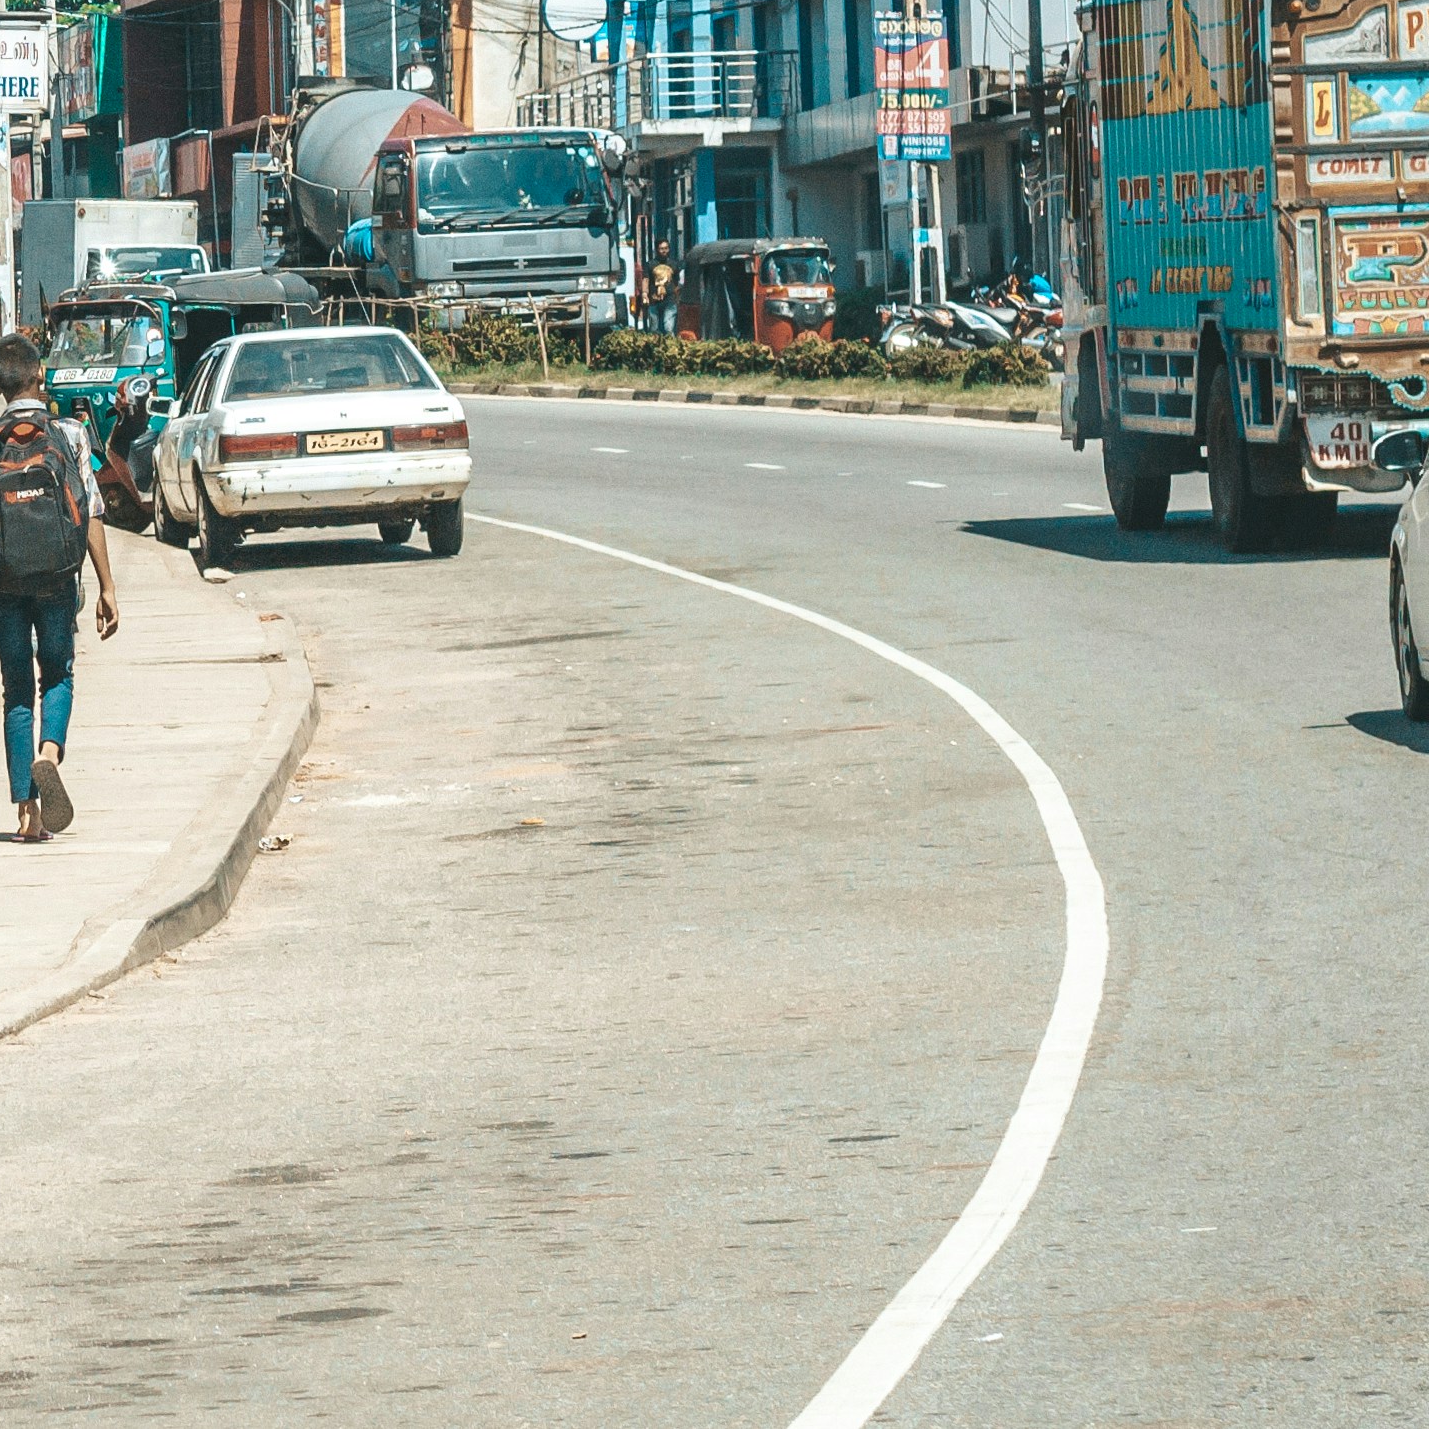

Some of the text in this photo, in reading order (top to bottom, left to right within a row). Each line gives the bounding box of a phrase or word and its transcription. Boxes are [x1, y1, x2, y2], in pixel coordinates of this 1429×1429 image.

[915, 40, 945, 88] 4
[1316, 156, 1383, 176] COMET
[1330, 422, 1363, 442] 40
[310, 435, 380, 450] 16-2164
